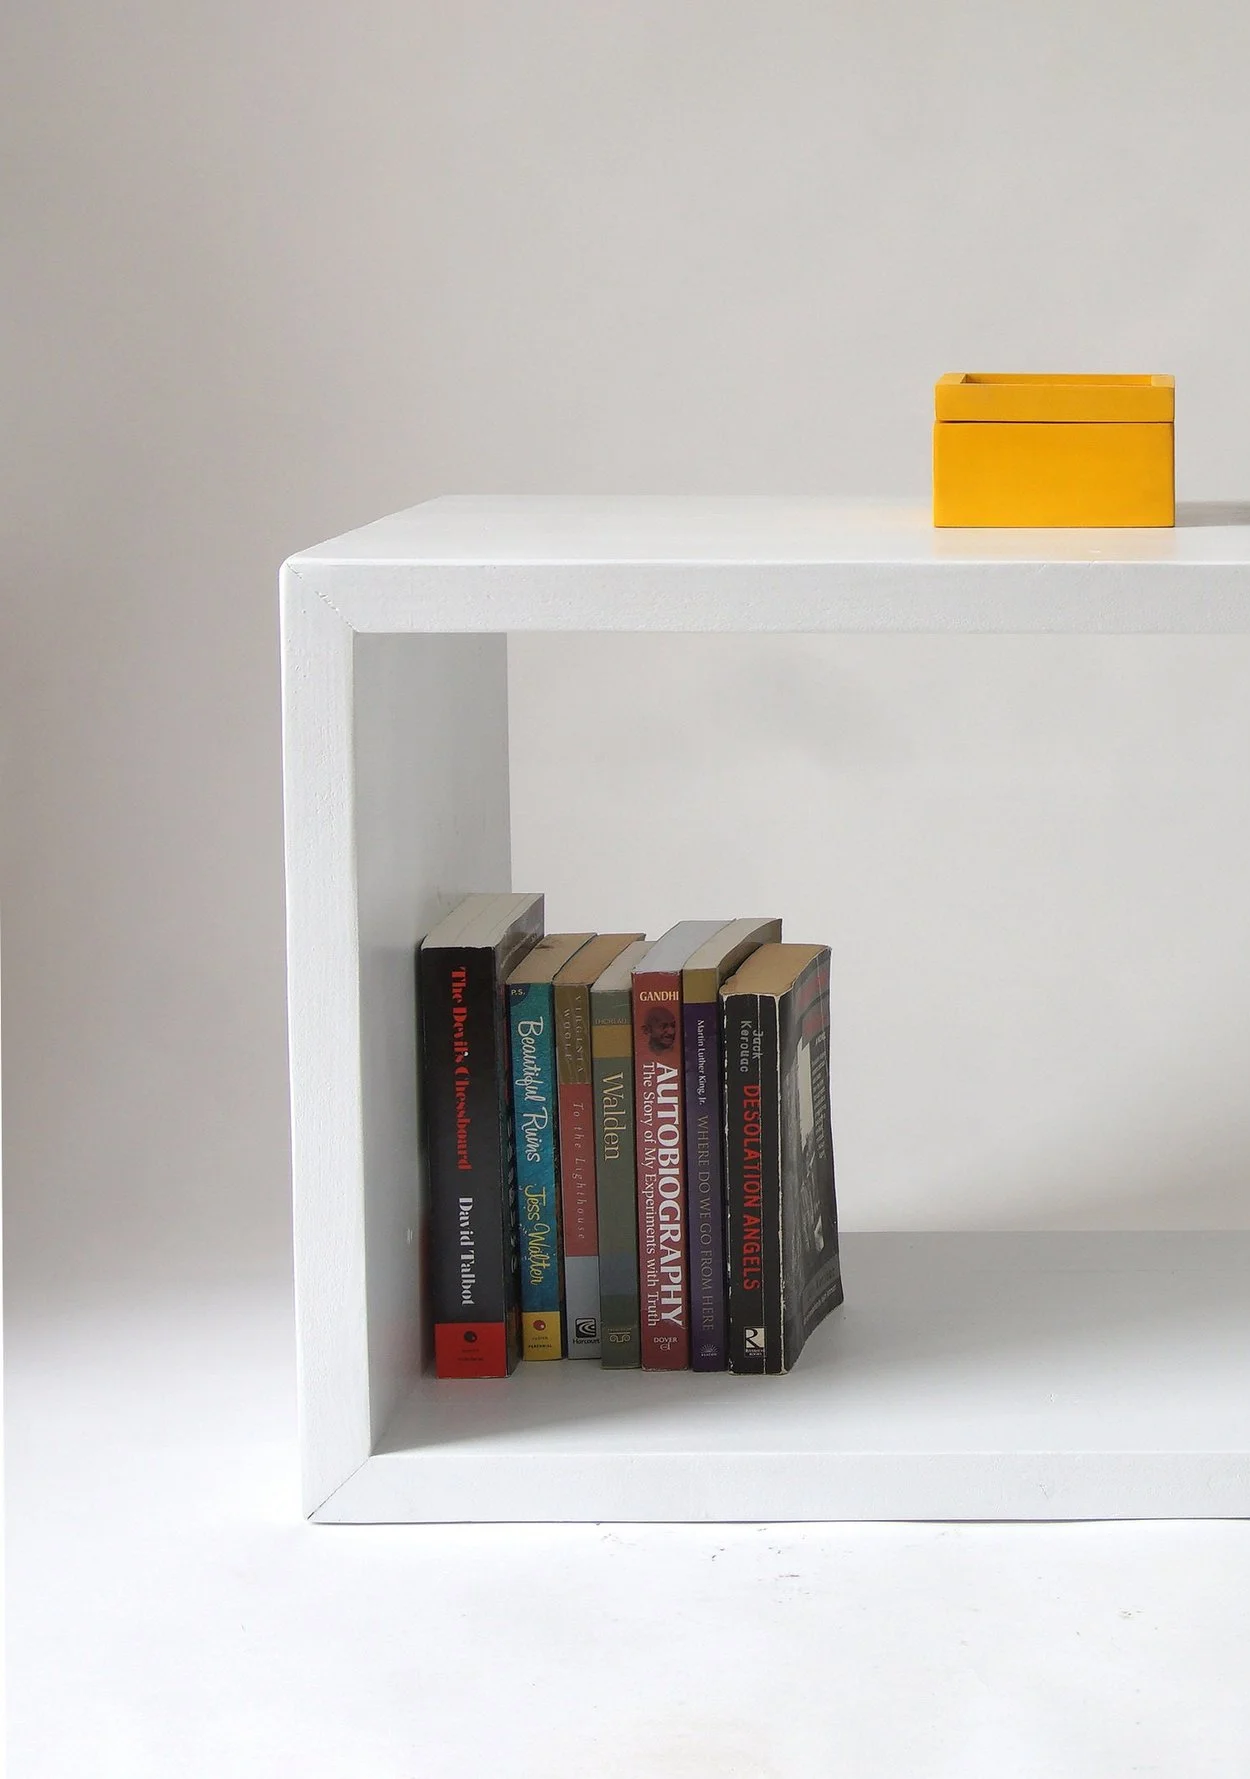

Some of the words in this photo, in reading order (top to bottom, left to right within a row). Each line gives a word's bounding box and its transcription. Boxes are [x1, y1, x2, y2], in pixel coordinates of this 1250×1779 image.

[452, 966, 466, 1003] The
[511, 988, 526, 996] P.S.
[640, 991, 679, 1002] GANDHI
[453, 1007, 469, 1063] Devil's
[697, 1020, 706, 1047] Martin
[740, 1020, 752, 1073] Kerouac
[752, 1029, 763, 1059] Jack
[515, 1016, 547, 1101] Beautiful
[643, 1062, 656, 1087] The
[698, 1048, 706, 1074] Luther
[455, 1066, 473, 1170] Chessboard
[573, 1102, 585, 1117] To
[603, 1072, 627, 1161] Walden
[640, 1092, 656, 1126] Story
[521, 1106, 548, 1163] Ruins
[574, 1127, 585, 1148] the
[644, 1130, 657, 1144] of
[697, 1115, 709, 1166] WHERE
[743, 1085, 762, 1207] DESOLATION
[641, 1147, 657, 1169] My
[572, 1157, 587, 1239] Lighthouse
[656, 1062, 683, 1329] AUTOBIOGRAPHY
[699, 1172, 711, 1194] DO
[524, 1185, 546, 1221] Jess
[641, 1174, 658, 1254] Experiments
[700, 1197, 712, 1220] WE
[459, 1197, 474, 1246] David
[700, 1223, 712, 1245] GO
[527, 1223, 551, 1285] Walter
[701, 1250, 713, 1290] FROM
[743, 1214, 761, 1291] ANGELS
[461, 1250, 476, 1306] Talbot
[646, 1258, 660, 1287] with
[647, 1292, 660, 1327] Truth
[702, 1295, 714, 1331] HERE
